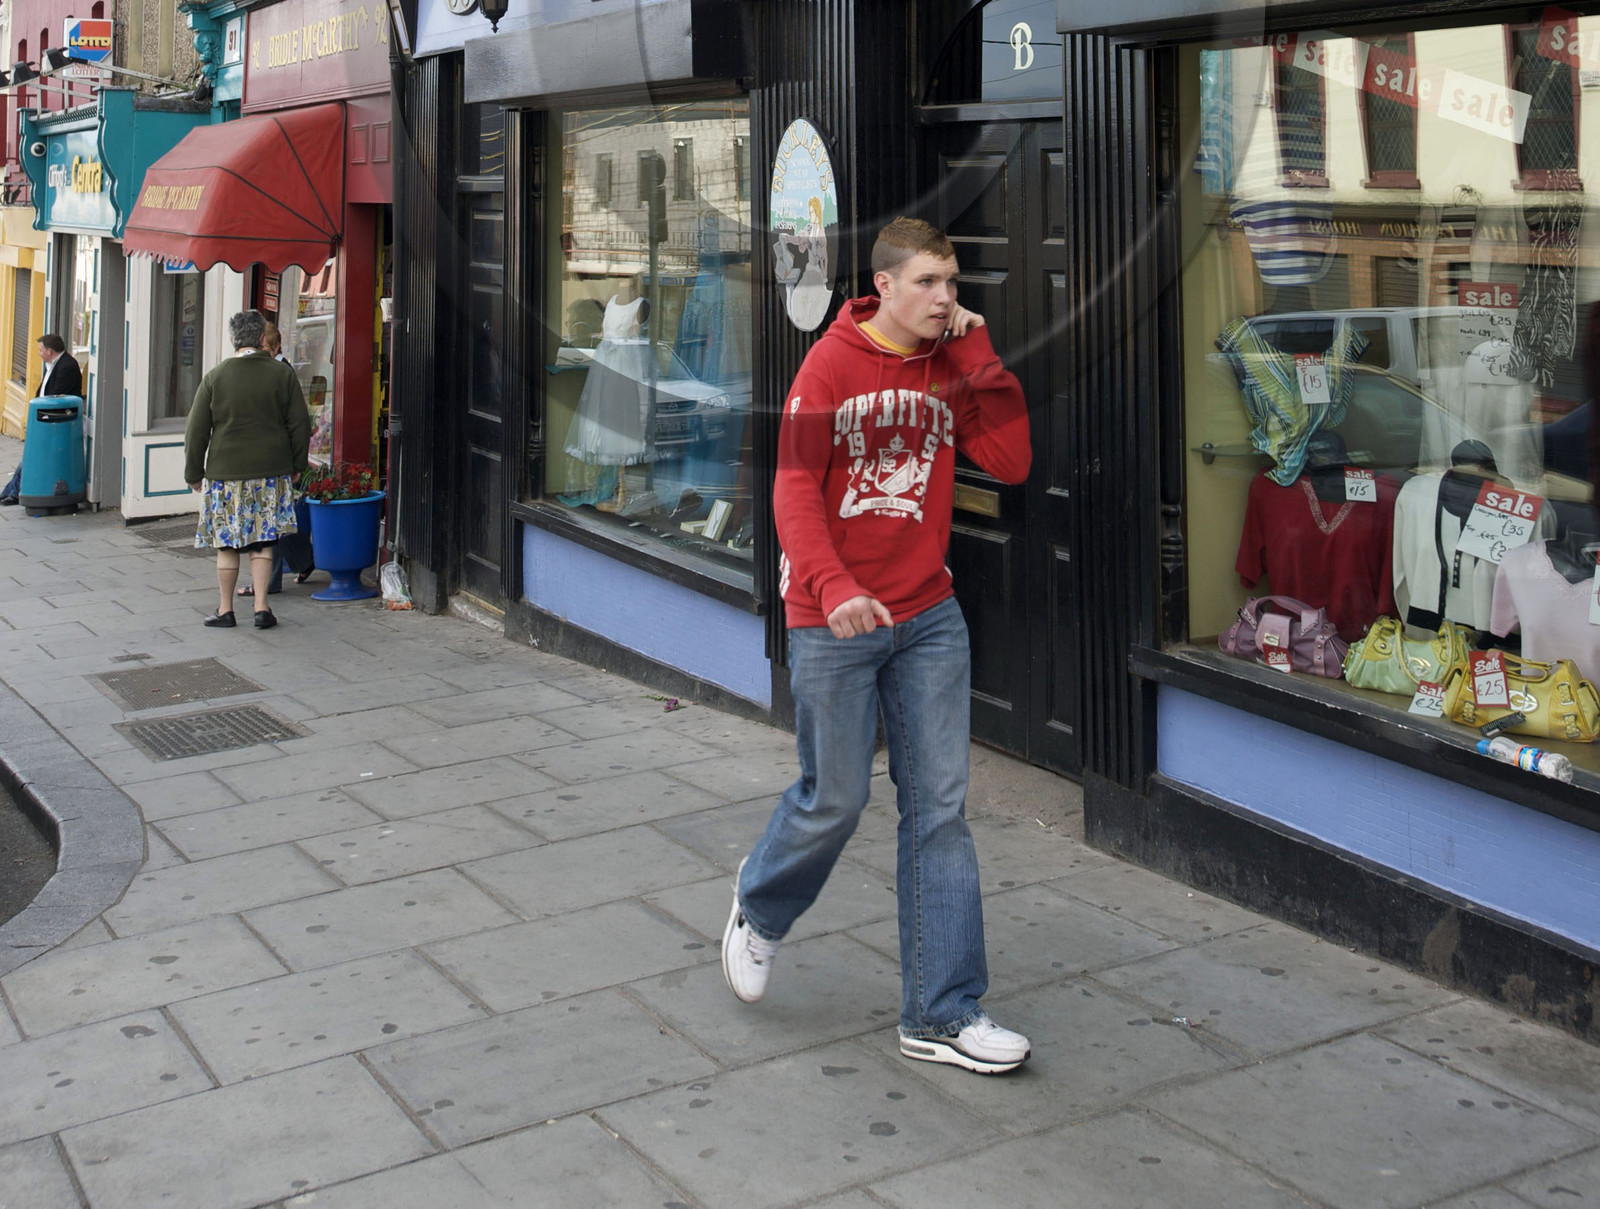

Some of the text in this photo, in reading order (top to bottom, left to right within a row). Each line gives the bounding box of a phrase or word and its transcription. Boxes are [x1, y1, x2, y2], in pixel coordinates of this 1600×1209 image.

[70, 35, 111, 47] LOTTO
[228, 29, 237, 51] 91
[268, 28, 301, 69] BRIDIE
[375, 2, 388, 47] 92
[1010, 22, 1034, 70] B
[1304, 40, 1356, 76] sale
[1373, 63, 1432, 101] sale
[1451, 88, 1514, 128] sale
[772, 121, 833, 194] BUCKLEY'S
[72, 154, 103, 193] Centra
[141, 185, 168, 207] BRIDIE
[1465, 286, 1513, 307] sale
[1296, 355, 1322, 367] sale
[1302, 373, 1322, 394] €15
[847, 432, 866, 458] 19
[1346, 470, 1372, 480] sale
[1349, 484, 1370, 497] €15
[1485, 492, 1534, 518] sale
[1502, 520, 1525, 537] €35
[1489, 540, 1512, 562] €2
[1474, 656, 1500, 674] Sale
[1476, 679, 1504, 697] €25
